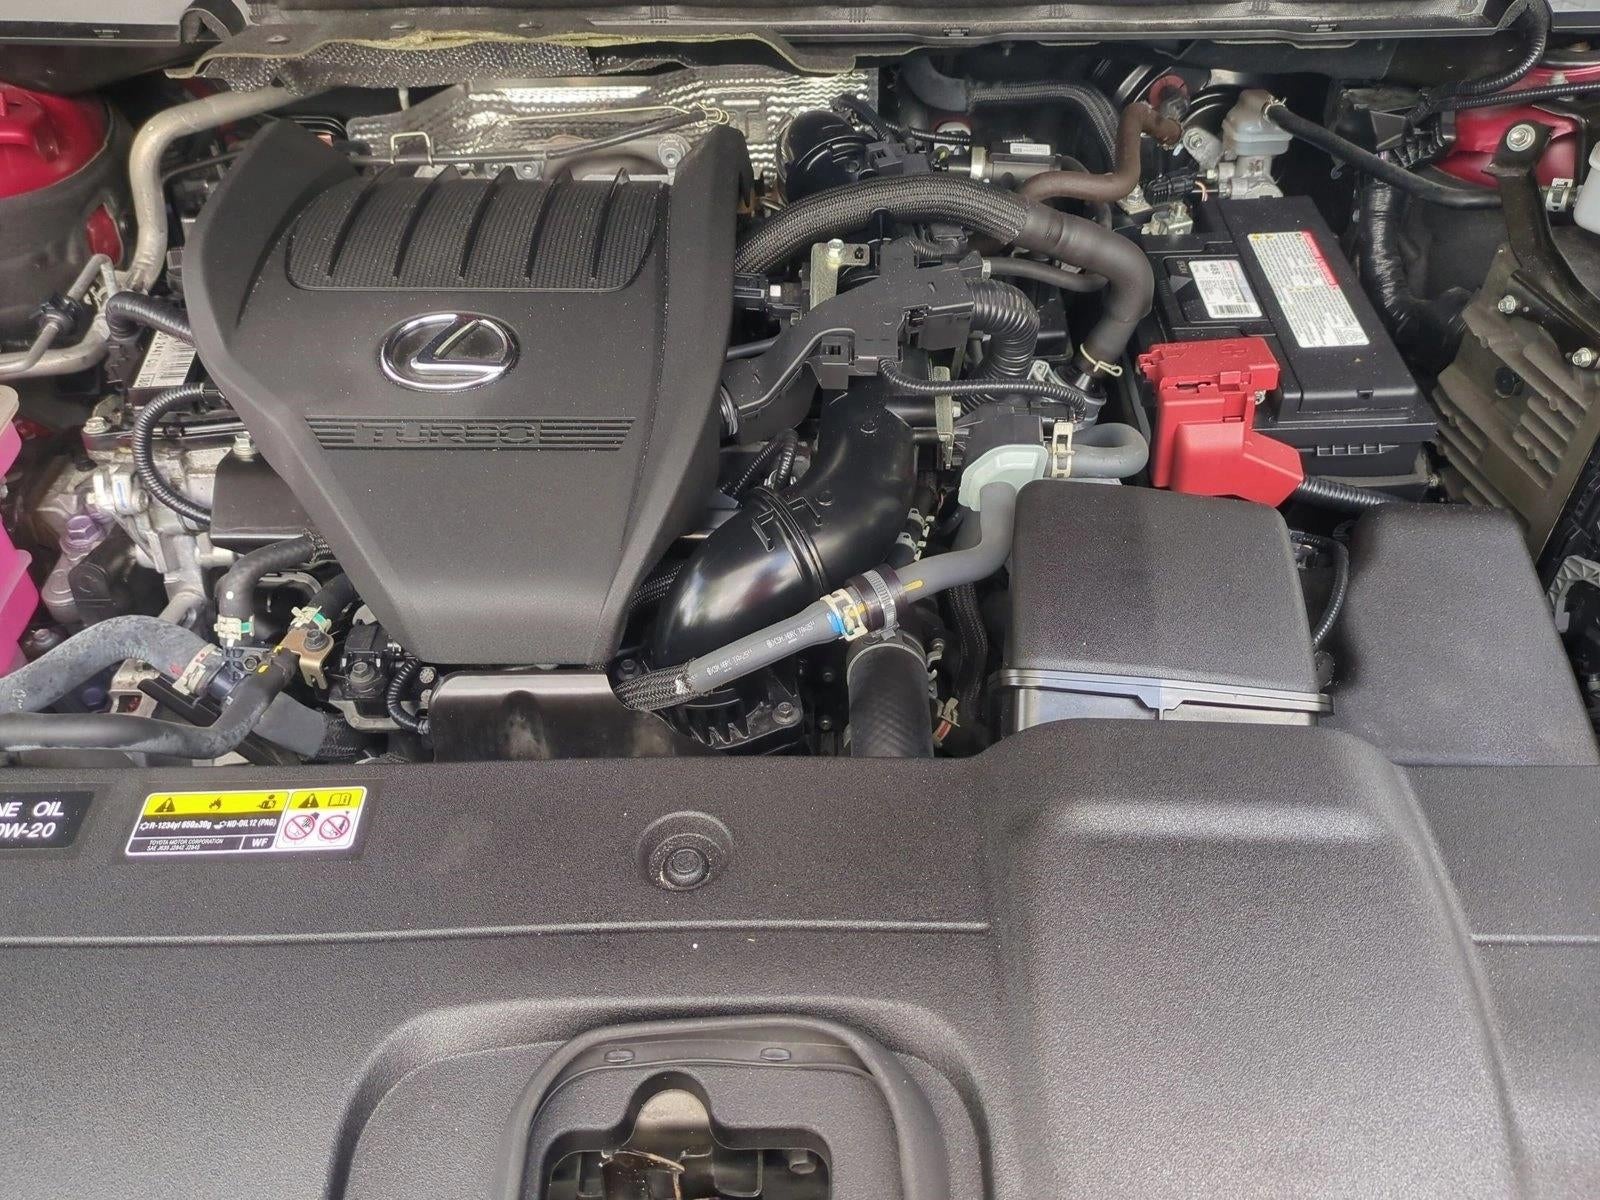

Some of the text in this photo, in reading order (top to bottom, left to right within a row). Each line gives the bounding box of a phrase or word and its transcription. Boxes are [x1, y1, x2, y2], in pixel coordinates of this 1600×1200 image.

[361, 423, 536, 443] TURBO
[33, 801, 65, 816] OIL
[251, 838, 269, 847] WF
